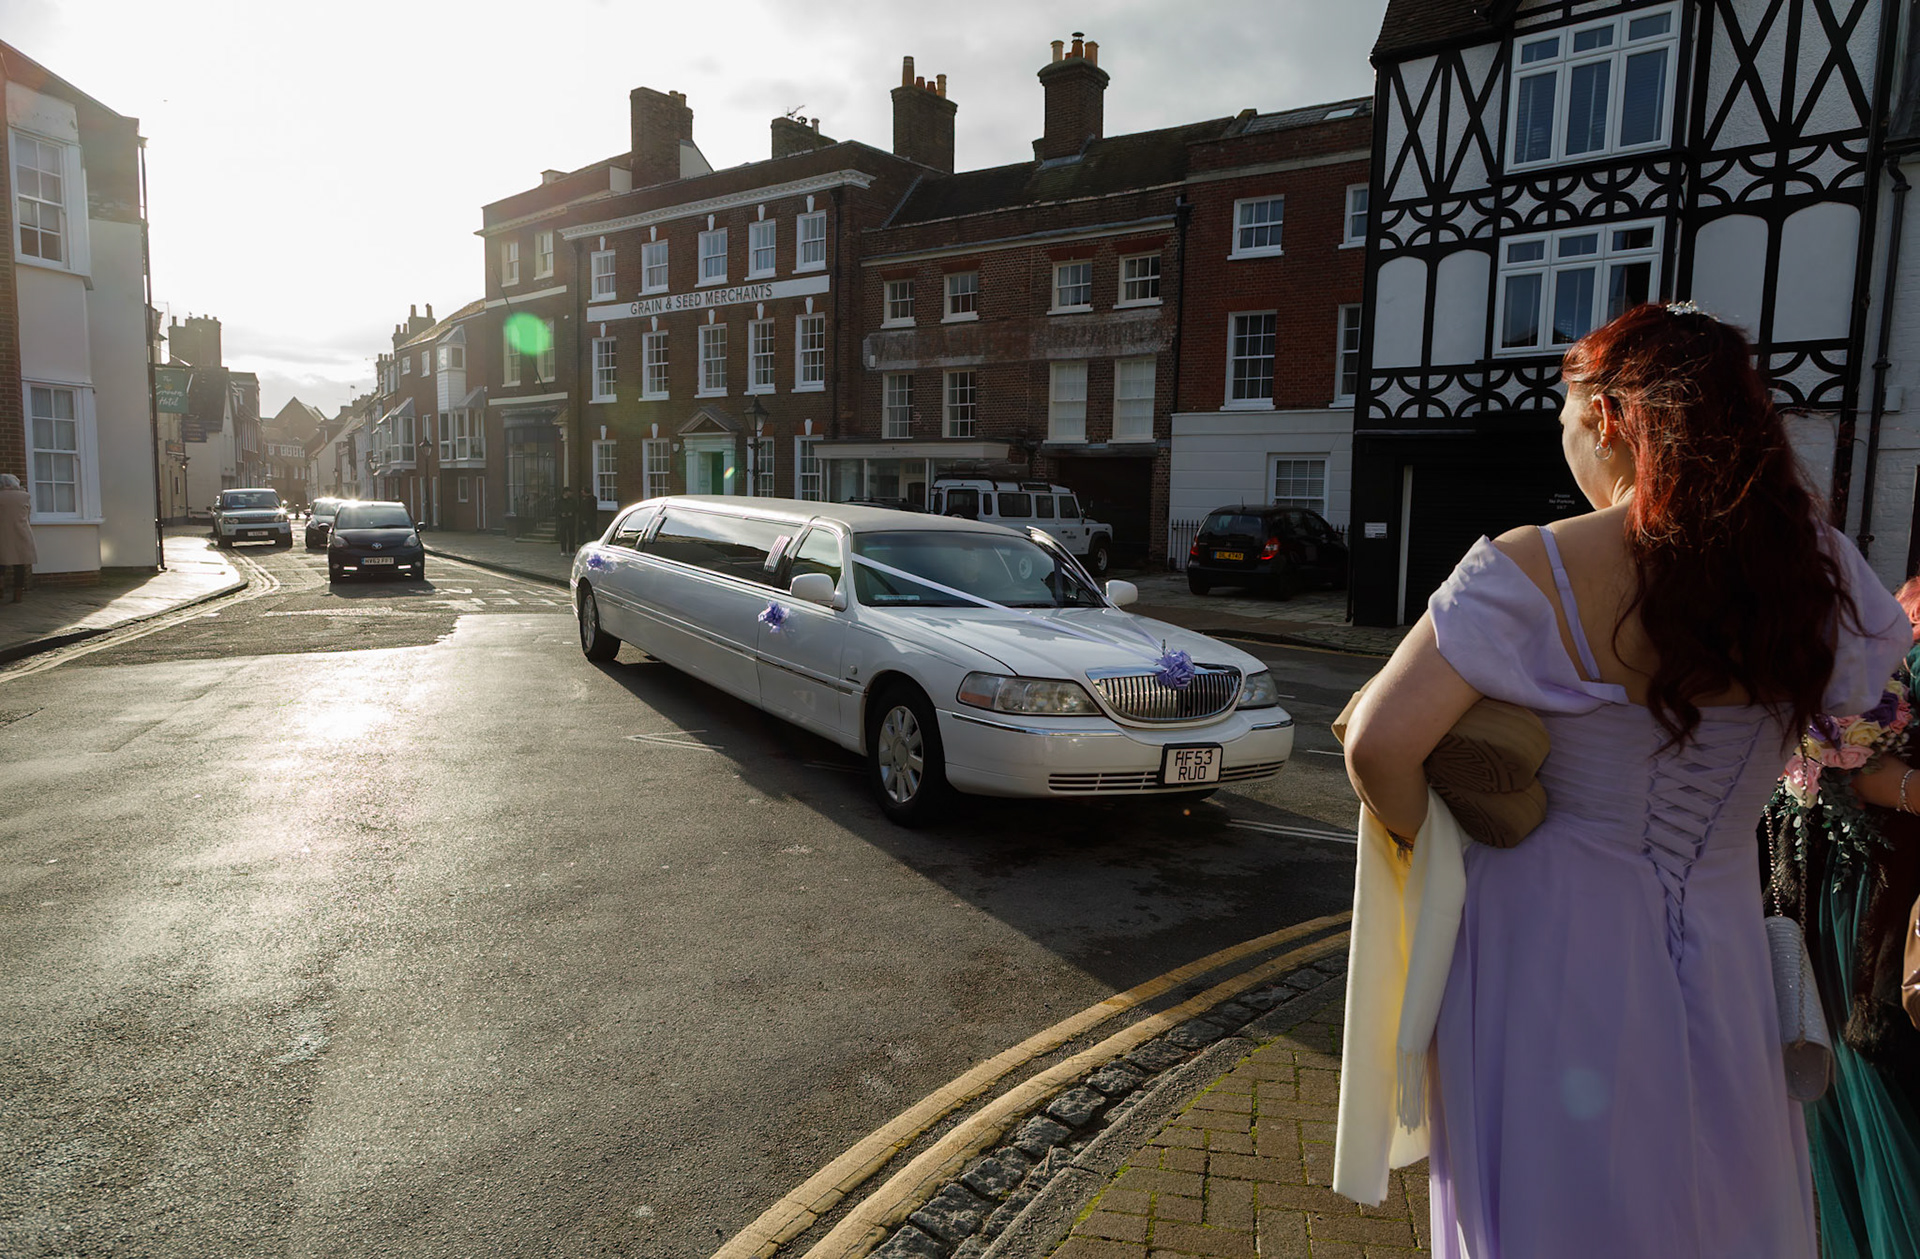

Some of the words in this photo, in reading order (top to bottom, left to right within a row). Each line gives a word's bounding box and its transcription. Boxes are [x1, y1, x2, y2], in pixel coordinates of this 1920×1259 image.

[630, 297, 662, 315] GRAIN
[665, 297, 672, 310] &
[676, 291, 701, 308] SEED
[705, 284, 773, 305] MERCHANTS
[1175, 750, 1213, 766] HF53
